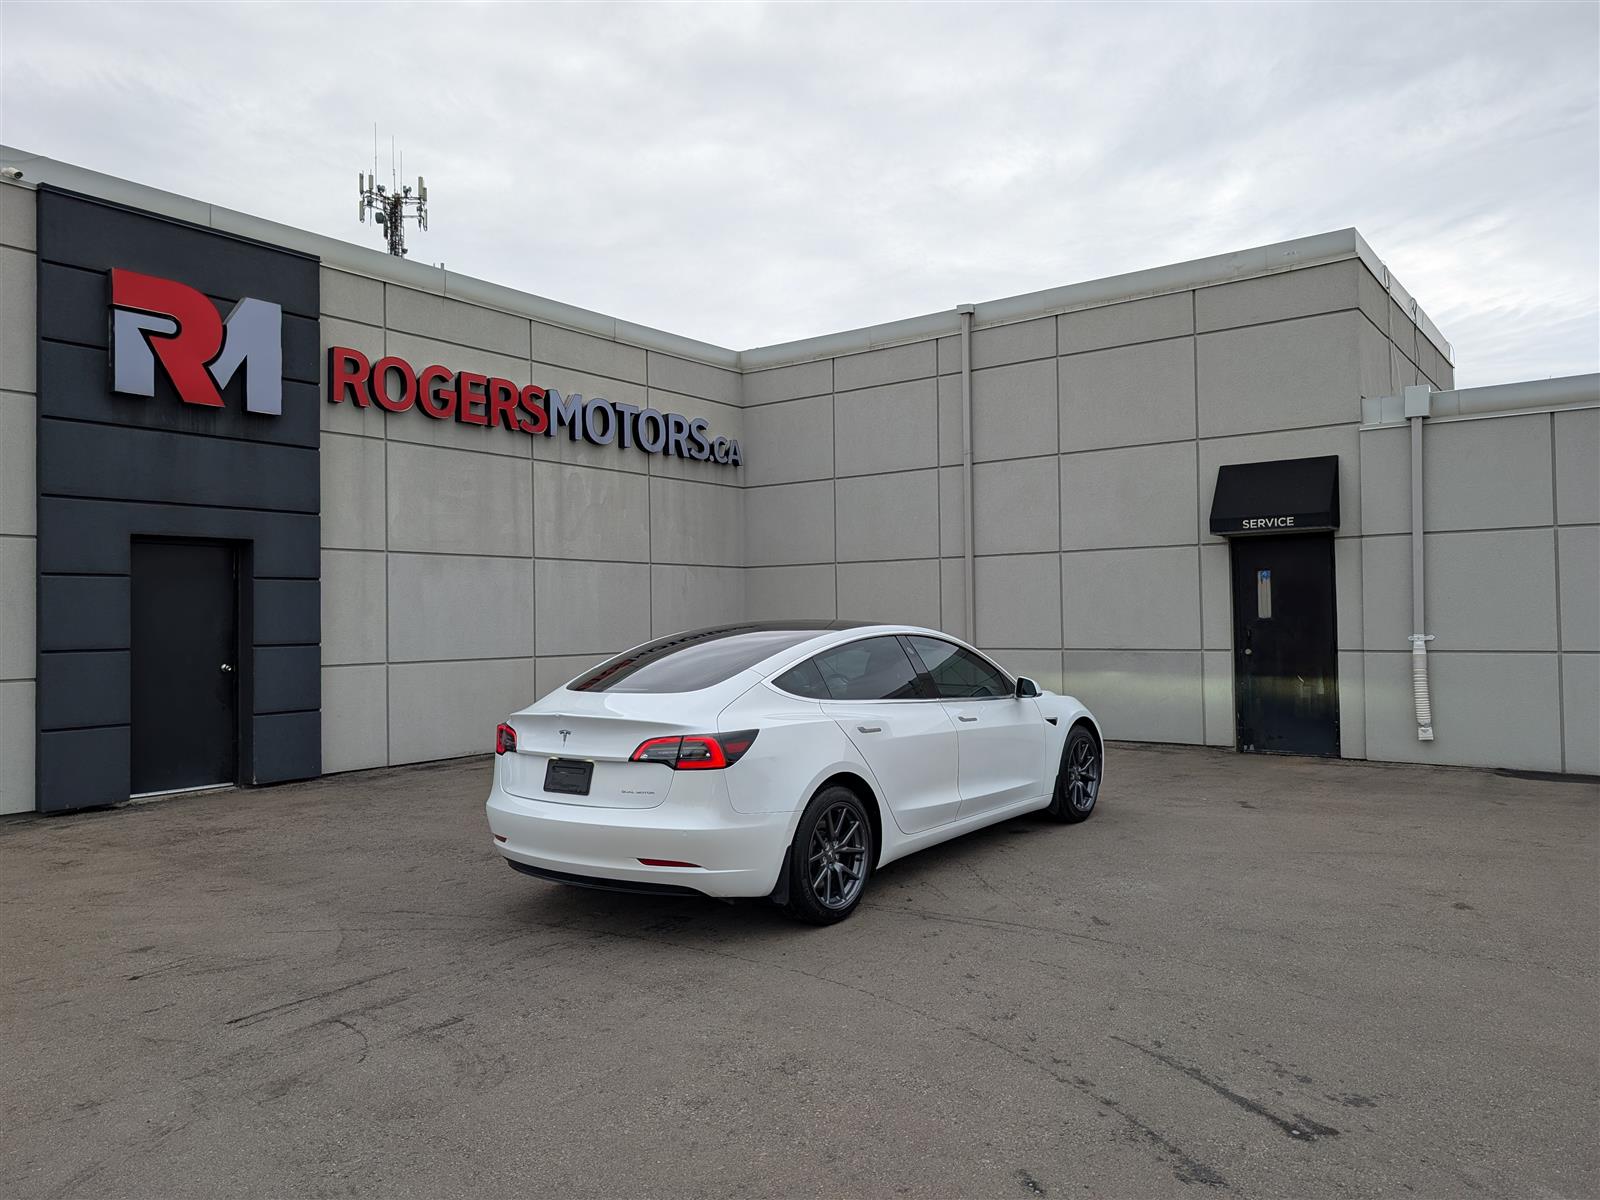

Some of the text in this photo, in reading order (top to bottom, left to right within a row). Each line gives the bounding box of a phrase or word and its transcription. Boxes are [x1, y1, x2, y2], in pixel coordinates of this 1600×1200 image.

[111, 267, 282, 415] RM
[328, 346, 742, 466] ROGERSMOTORS.CA
[1242, 516, 1294, 529] SERVICE
